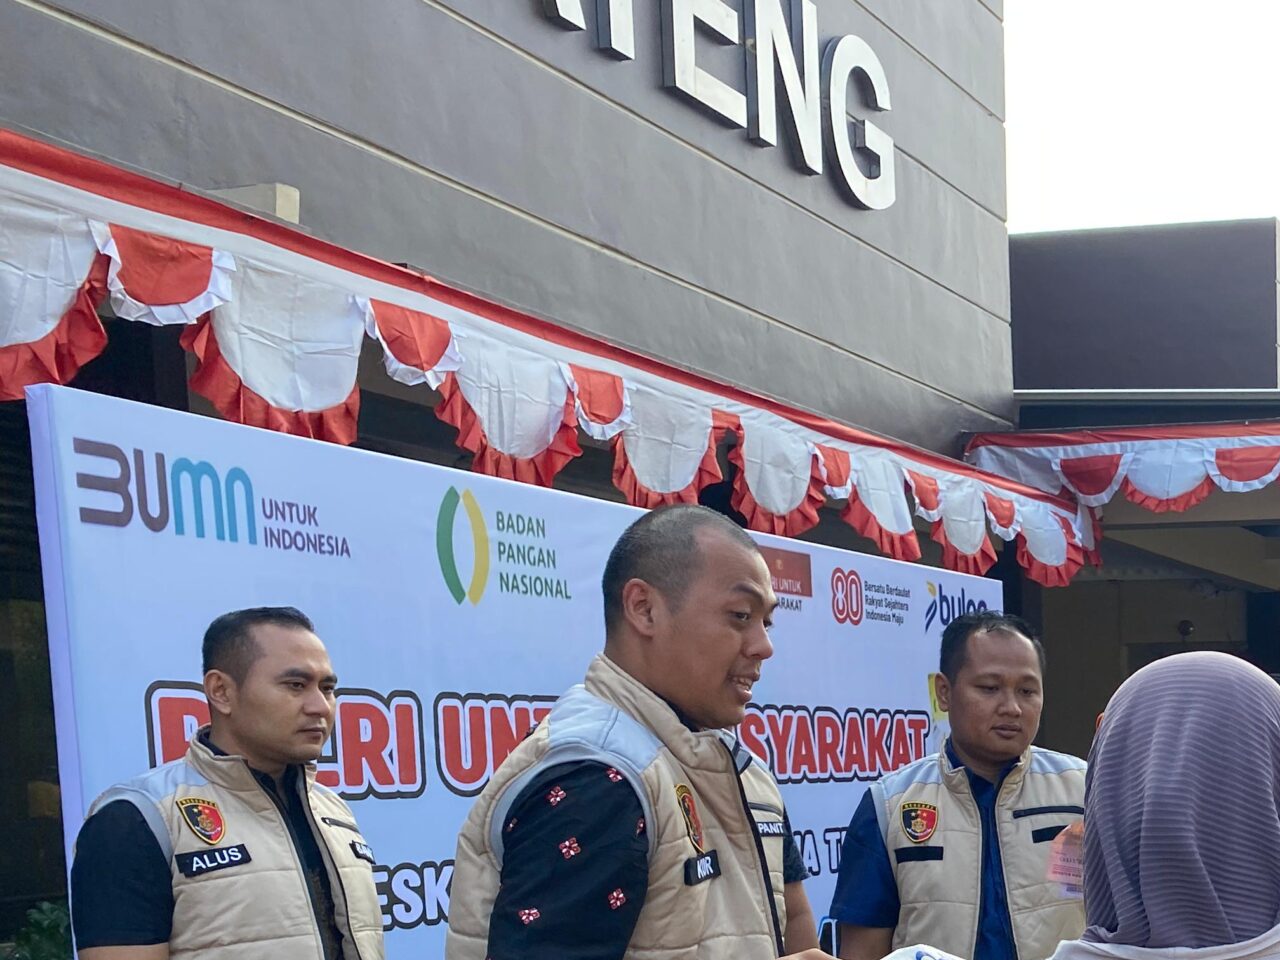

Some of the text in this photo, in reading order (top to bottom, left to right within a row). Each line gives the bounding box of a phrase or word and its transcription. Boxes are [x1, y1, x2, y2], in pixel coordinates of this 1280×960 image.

[261, 497, 318, 527] UNTUK
[496, 510, 546, 539] BADAN
[264, 526, 351, 559] INDONESIA
[497, 541, 556, 569] PANGAN
[499, 571, 572, 600] NASIONAL
[779, 578, 802, 593] UNTUK
[831, 567, 864, 626] 80
[864, 580, 911, 598] Bersatu Berdaulat
[864, 594, 909, 612] Rakyat Sejahtera
[865, 609, 904, 626] Indonesia Maju
[192, 847, 242, 871] ALUS
